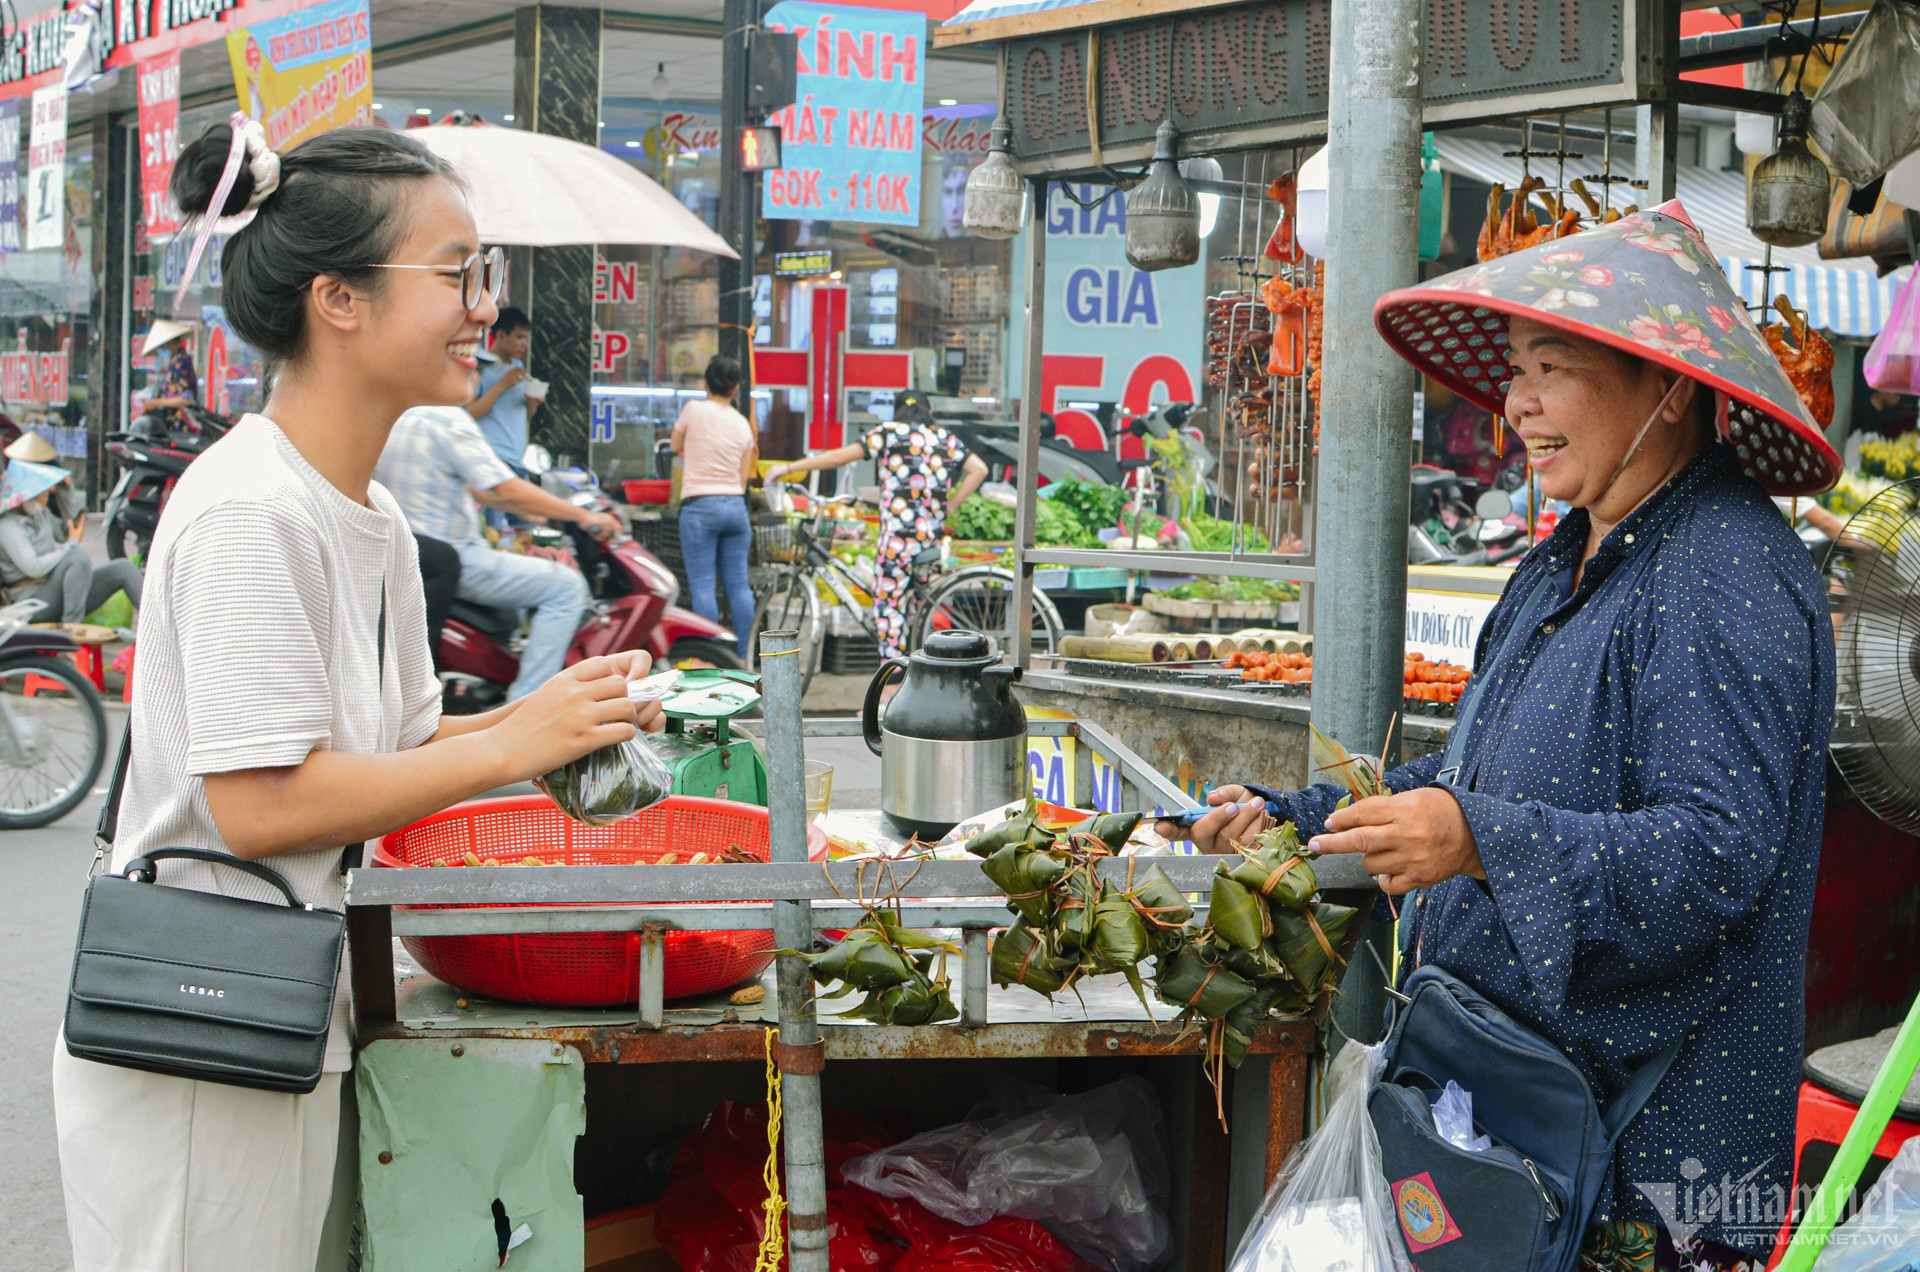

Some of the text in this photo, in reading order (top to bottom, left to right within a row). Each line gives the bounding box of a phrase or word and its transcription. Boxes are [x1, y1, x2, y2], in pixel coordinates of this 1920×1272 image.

[663, 112, 720, 149] Kín
[848, 108, 916, 153] NAM
[922, 114, 992, 152] Khác
[770, 168, 823, 209] 60K
[847, 171, 911, 214] 110K
[180, 984, 225, 998] LESAC
